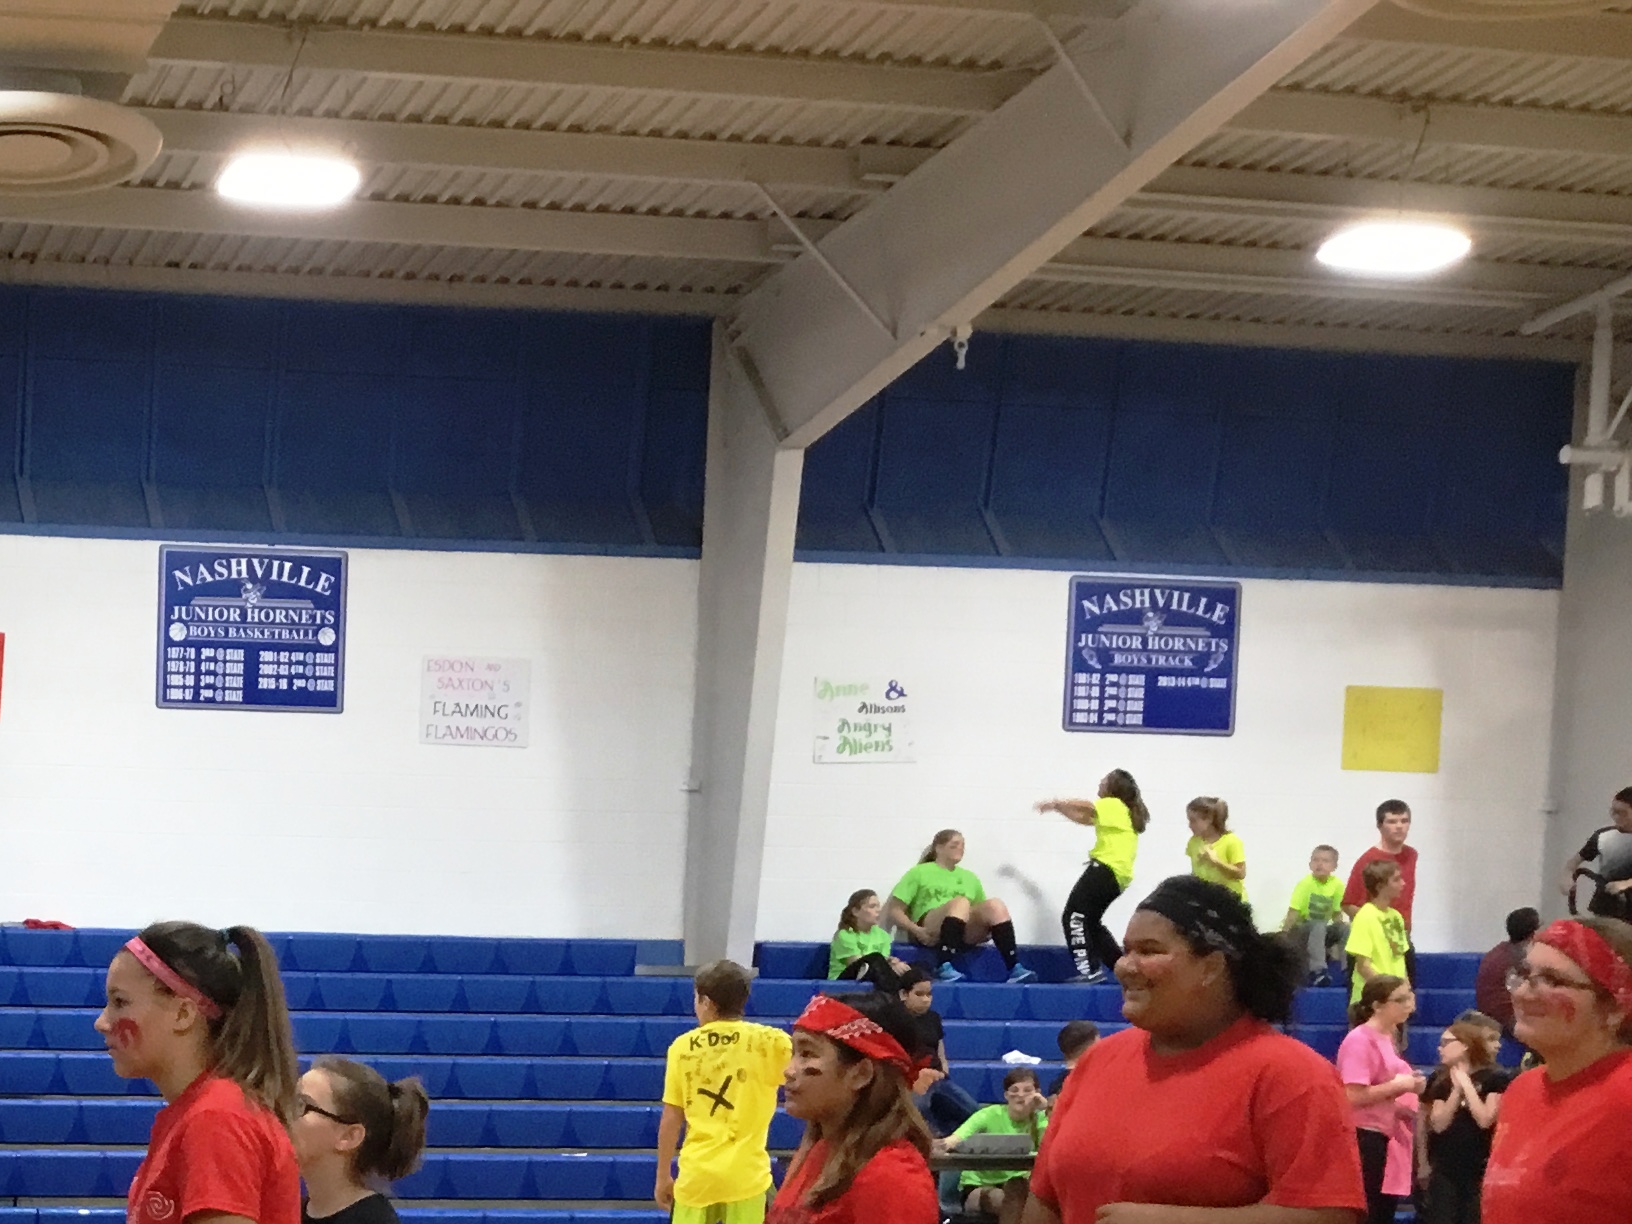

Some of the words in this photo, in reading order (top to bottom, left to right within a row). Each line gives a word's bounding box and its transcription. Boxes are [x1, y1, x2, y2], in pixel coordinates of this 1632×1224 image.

[172, 558, 335, 596] NASHVILLE
[170, 606, 241, 622] JUNIOR
[246, 608, 335, 624] HORNETS
[1082, 588, 1230, 625] NASHVILLE
[189, 625, 225, 637] BOYS
[228, 627, 316, 641] BASKETBALL
[1078, 633, 1143, 649] JUNIOR
[1147, 636, 1229, 652] HORNETS
[1114, 653, 1149, 665] BOYS
[1151, 655, 1194, 666] TRACK
[885, 679, 908, 701] &
[433, 700, 509, 720] FLAMING
[426, 724, 518, 742] FLAMINGOS
[837, 718, 892, 738] Angry
[836, 735, 894, 756] Aliens
[1070, 912, 1086, 946] LOVE
